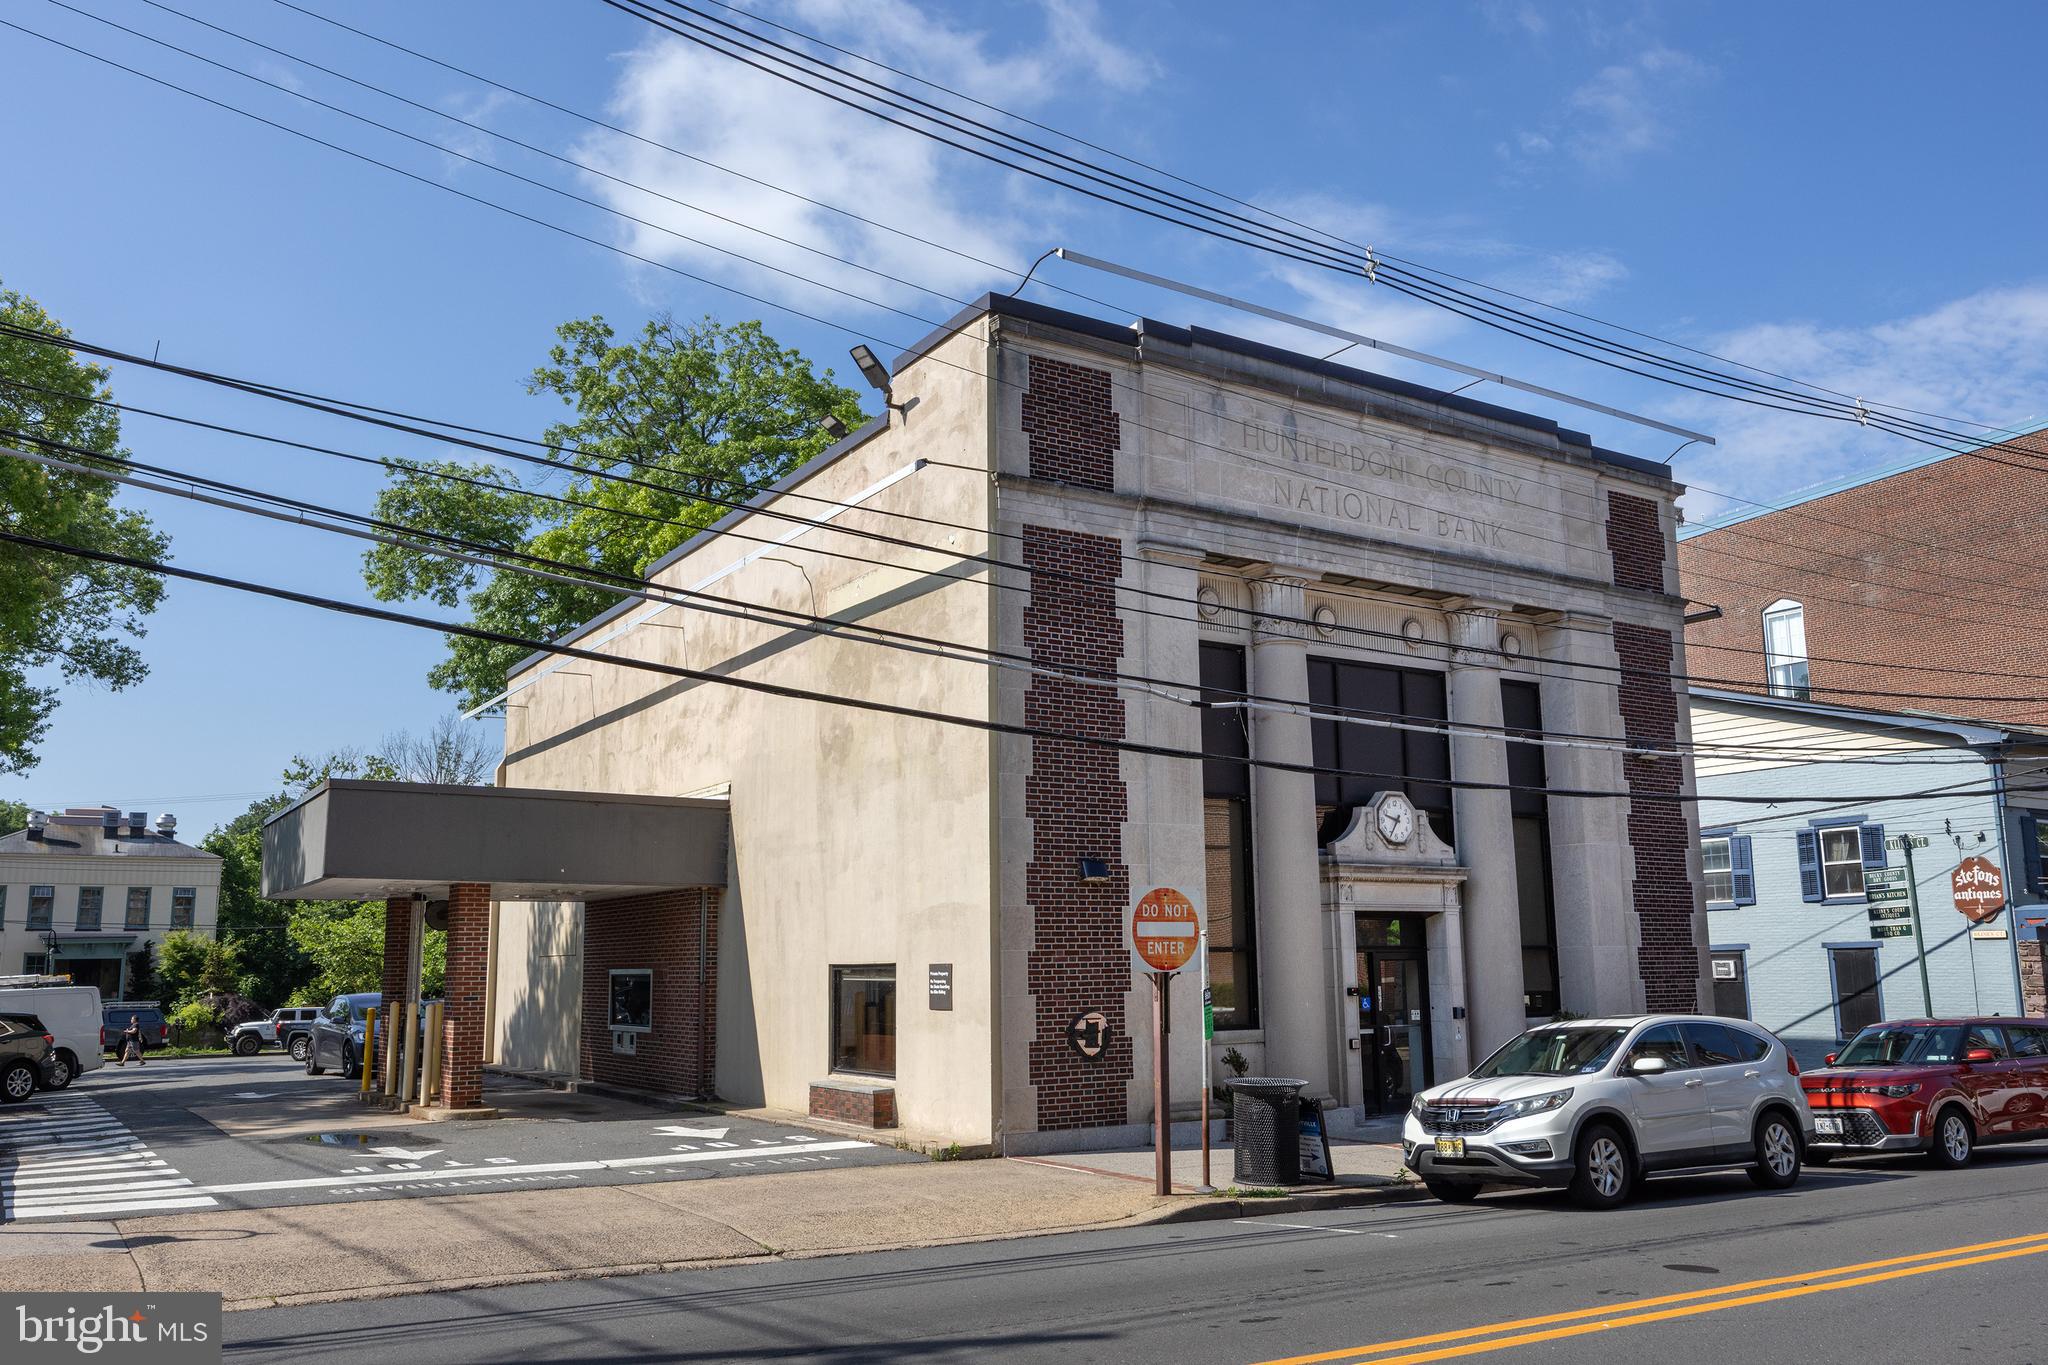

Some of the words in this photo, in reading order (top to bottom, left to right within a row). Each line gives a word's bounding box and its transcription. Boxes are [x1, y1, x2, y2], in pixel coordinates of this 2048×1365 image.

[1242, 422, 1404, 480] HUNTERDON
[1426, 464, 1522, 506] COUNTY
[1273, 477, 1421, 531] NATIONAL
[1437, 511, 1506, 548] BANK
[1954, 886, 2002, 904] antiques
[1143, 903, 1159, 918] DO
[1165, 904, 1189, 918] NOT
[1147, 941, 1185, 956] ENTER
